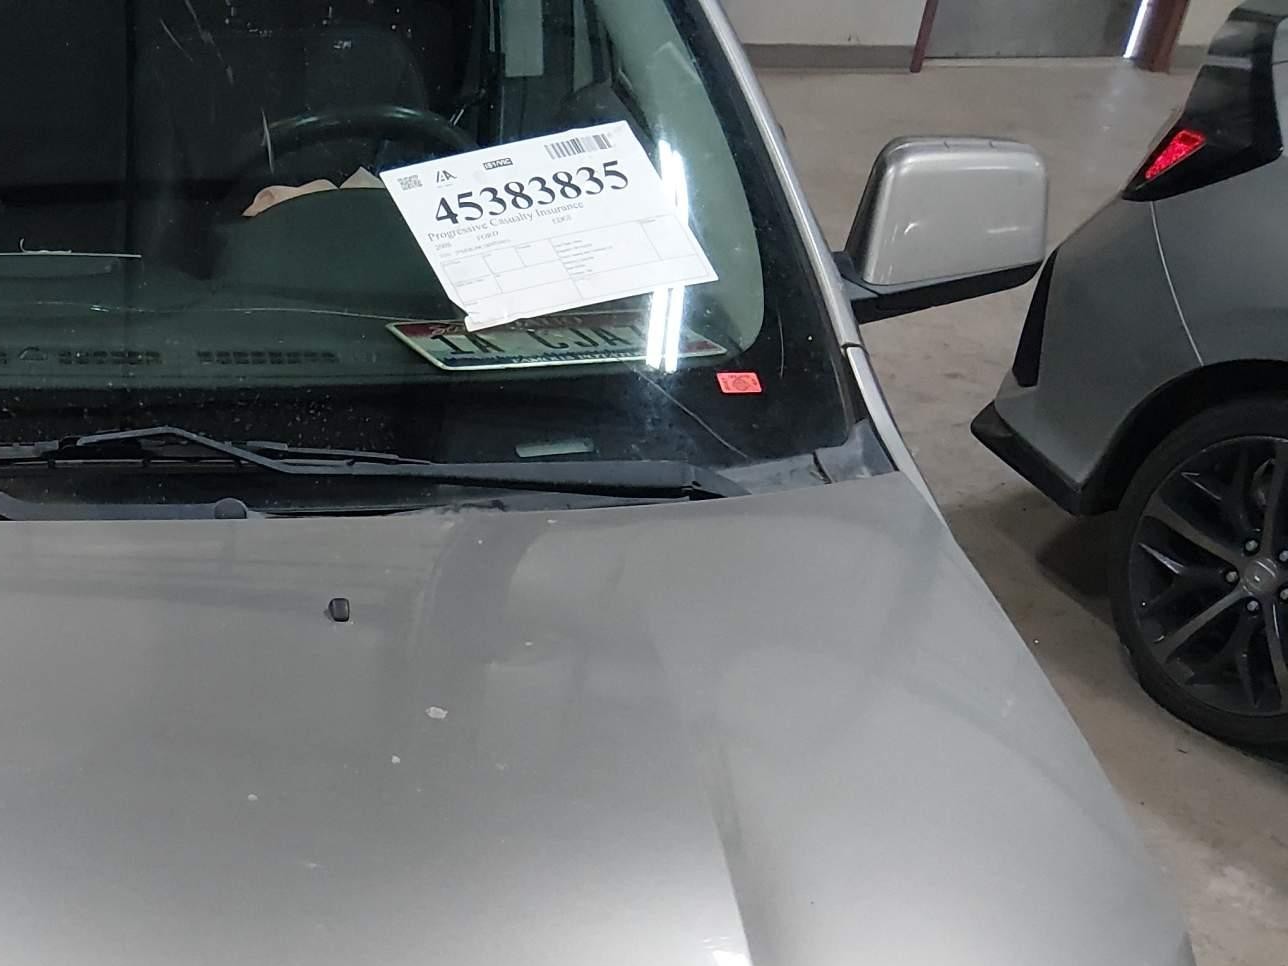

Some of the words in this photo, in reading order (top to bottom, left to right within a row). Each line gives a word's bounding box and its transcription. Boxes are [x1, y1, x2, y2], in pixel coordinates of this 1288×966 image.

[435, 160, 629, 224] 45383835
[427, 223, 489, 242] Progressive
[489, 211, 534, 227] Casualty
[535, 201, 584, 217] Insurance
